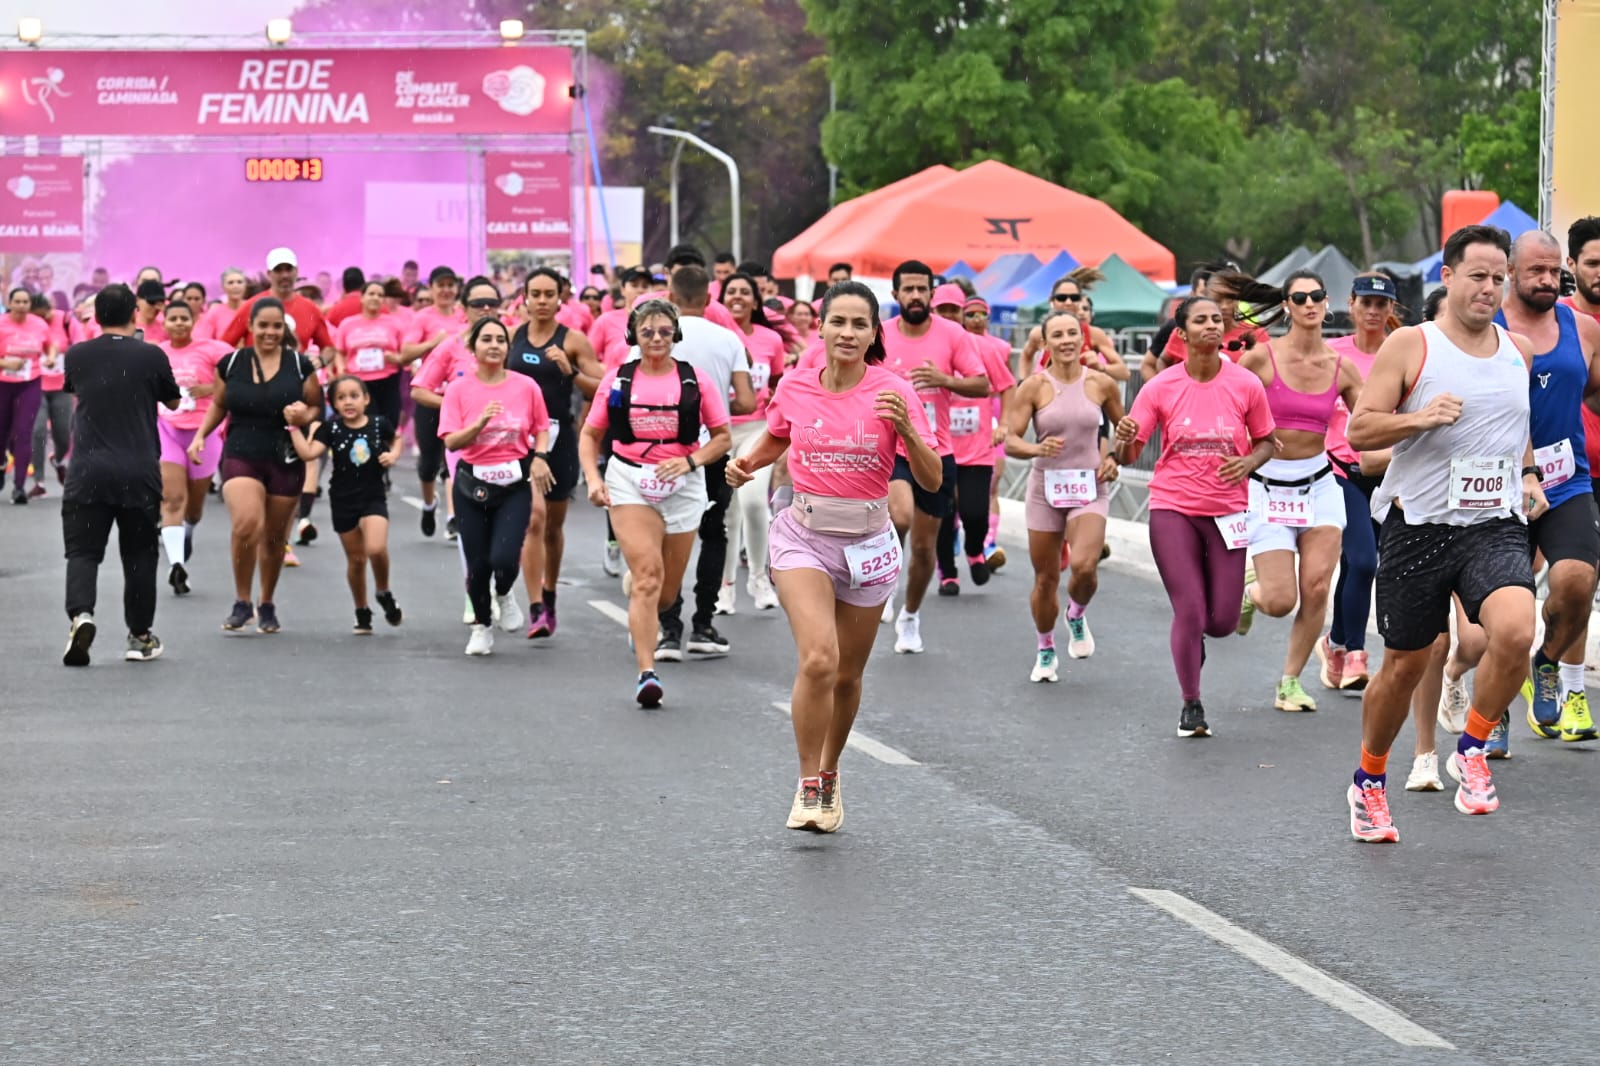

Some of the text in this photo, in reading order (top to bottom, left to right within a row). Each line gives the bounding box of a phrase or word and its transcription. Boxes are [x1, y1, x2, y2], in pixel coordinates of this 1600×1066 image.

[239, 59, 334, 90] REDE
[395, 71, 414, 83] DE
[96, 75, 169, 91] CORRIDA /
[395, 82, 457, 95] COMBATE
[97, 91, 178, 105] CAMINHADA
[395, 95, 415, 108] AO
[197, 93, 369, 124] FEMININA
[0, 224, 39, 236] CAIXA
[487, 221, 529, 233] CAIXA
[810, 452, 880, 463] CORRIDA
[481, 470, 514, 481] 5203
[640, 479, 676, 493] 5377
[1053, 483, 1087, 494] 5156
[1461, 475, 1503, 493] 7008
[1268, 500, 1304, 513] 5311
[861, 546, 898, 576] 5233
